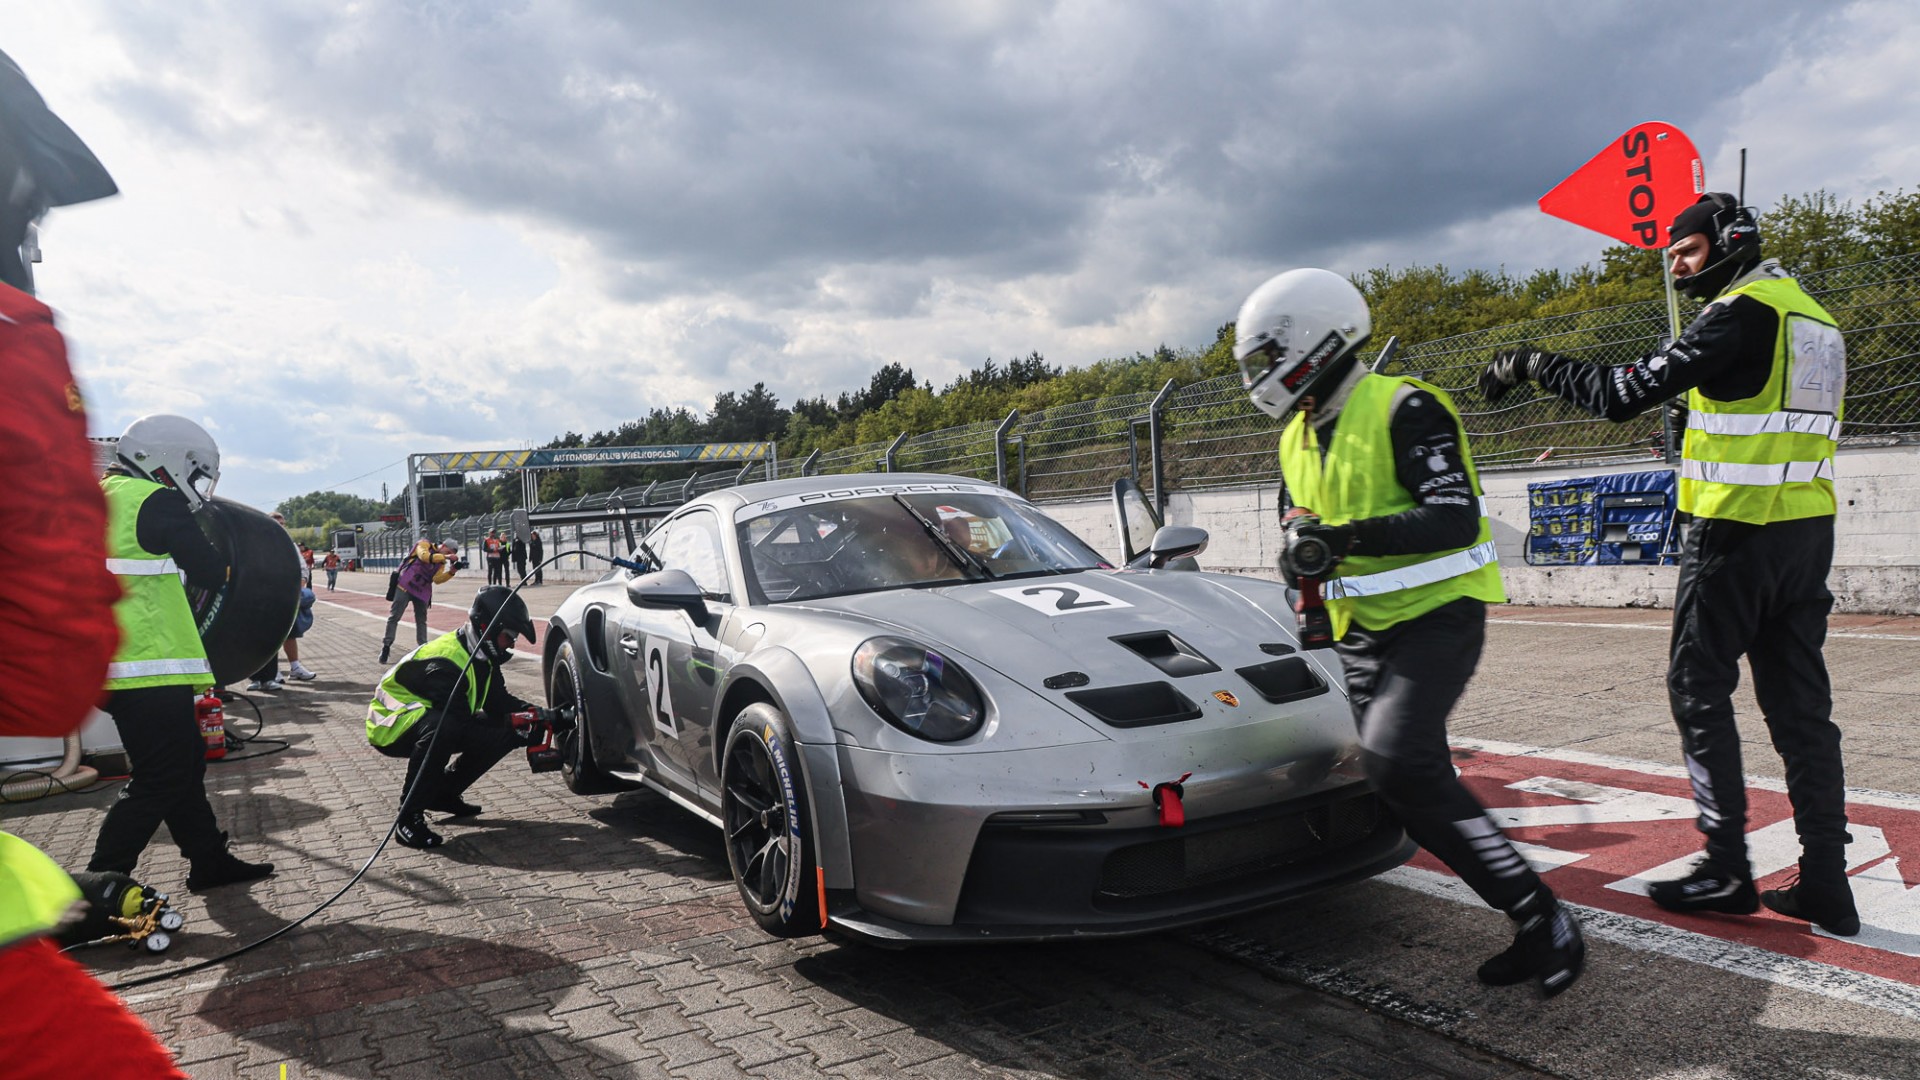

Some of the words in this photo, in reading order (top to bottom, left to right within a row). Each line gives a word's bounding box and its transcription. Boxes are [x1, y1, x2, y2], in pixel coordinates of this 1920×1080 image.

[1623, 131, 1659, 247] STOP
[553, 453, 620, 463] AUTOMOBILKLUB
[621, 450, 680, 460] WIELKOPOLSKI
[799, 484, 980, 503] PORSCHE
[1021, 587, 1112, 611] 2
[649, 648, 674, 729] 2
[773, 750, 799, 829] MICHELIN
